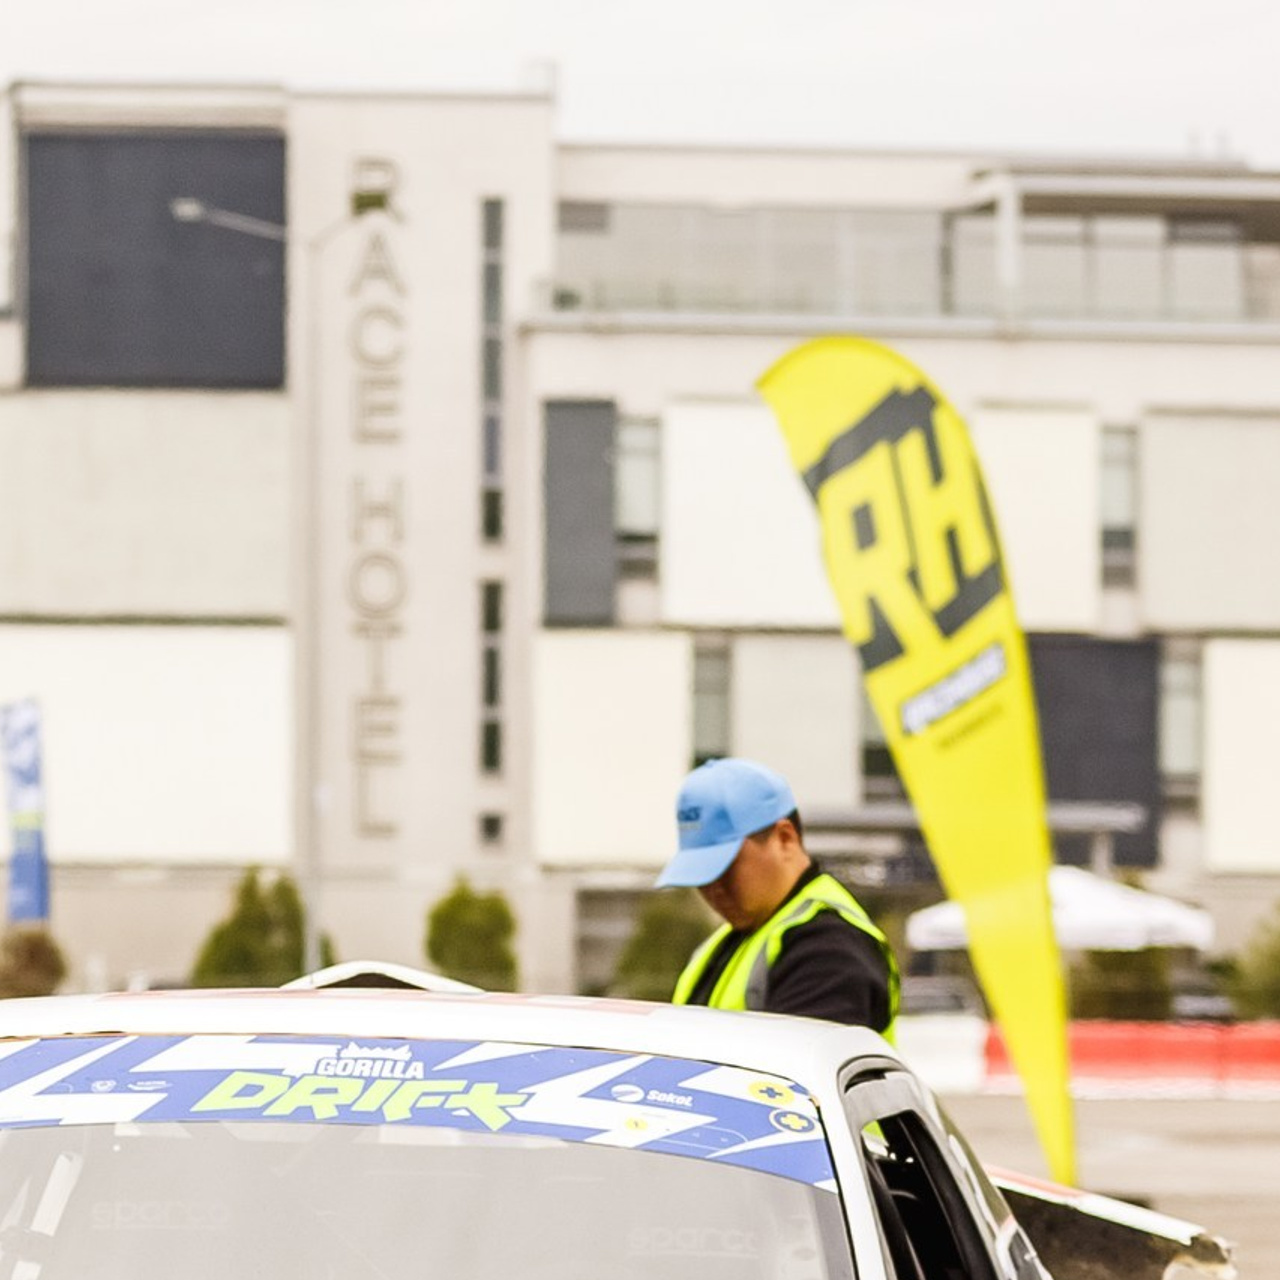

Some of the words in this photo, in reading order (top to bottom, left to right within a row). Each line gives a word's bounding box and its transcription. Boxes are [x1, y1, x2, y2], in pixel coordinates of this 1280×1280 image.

[350, 157, 406, 446] RACE
[348, 475, 407, 839] HOTEL
[189, 1070, 528, 1132] DRIFT
[316, 1056, 425, 1080] GORILLA
